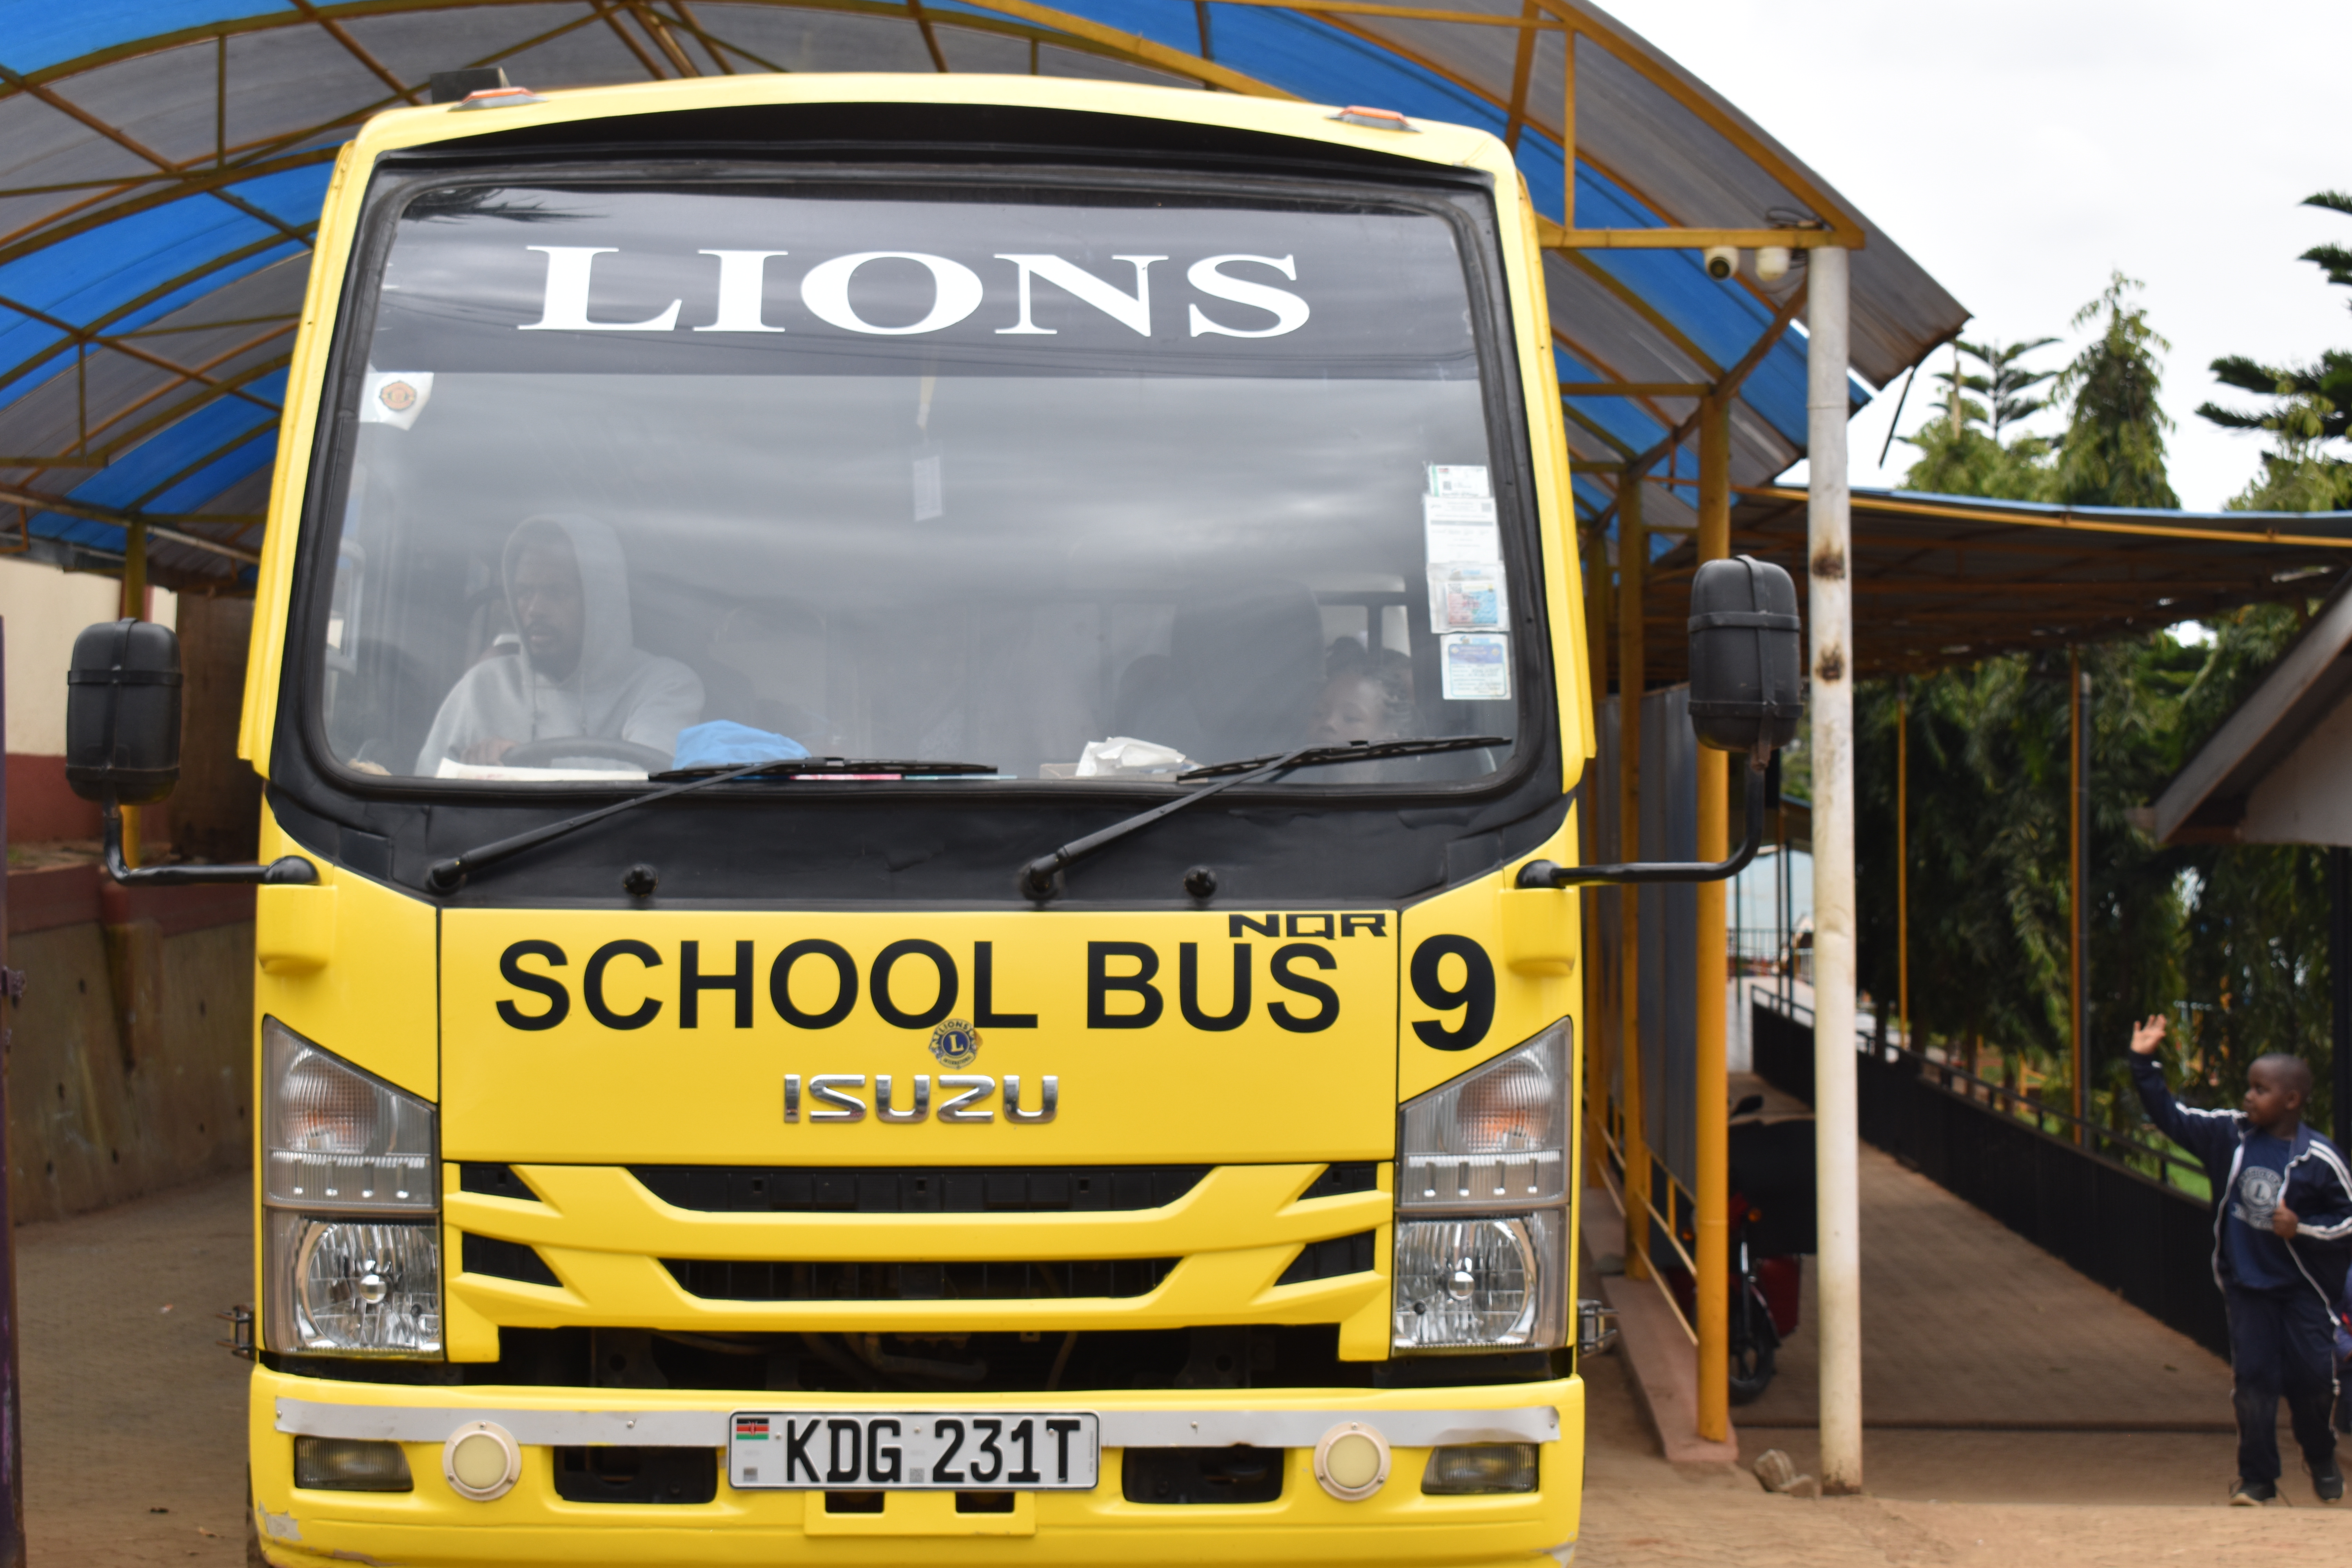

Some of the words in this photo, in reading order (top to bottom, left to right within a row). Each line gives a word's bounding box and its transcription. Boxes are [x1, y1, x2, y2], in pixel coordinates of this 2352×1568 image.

[517, 245, 1310, 338] LIONS
[1229, 914, 1388, 940] NQR
[496, 939, 1038, 1031] SCHOOL
[1087, 941, 1340, 1033] BUS
[1410, 934, 1495, 1051] 9
[939, 1022, 968, 1033] LIONS
[949, 1034, 964, 1052] L
[784, 1074, 1058, 1123] ISUZU
[787, 1419, 901, 1483] KDG
[933, 1419, 1080, 1483] 231T
